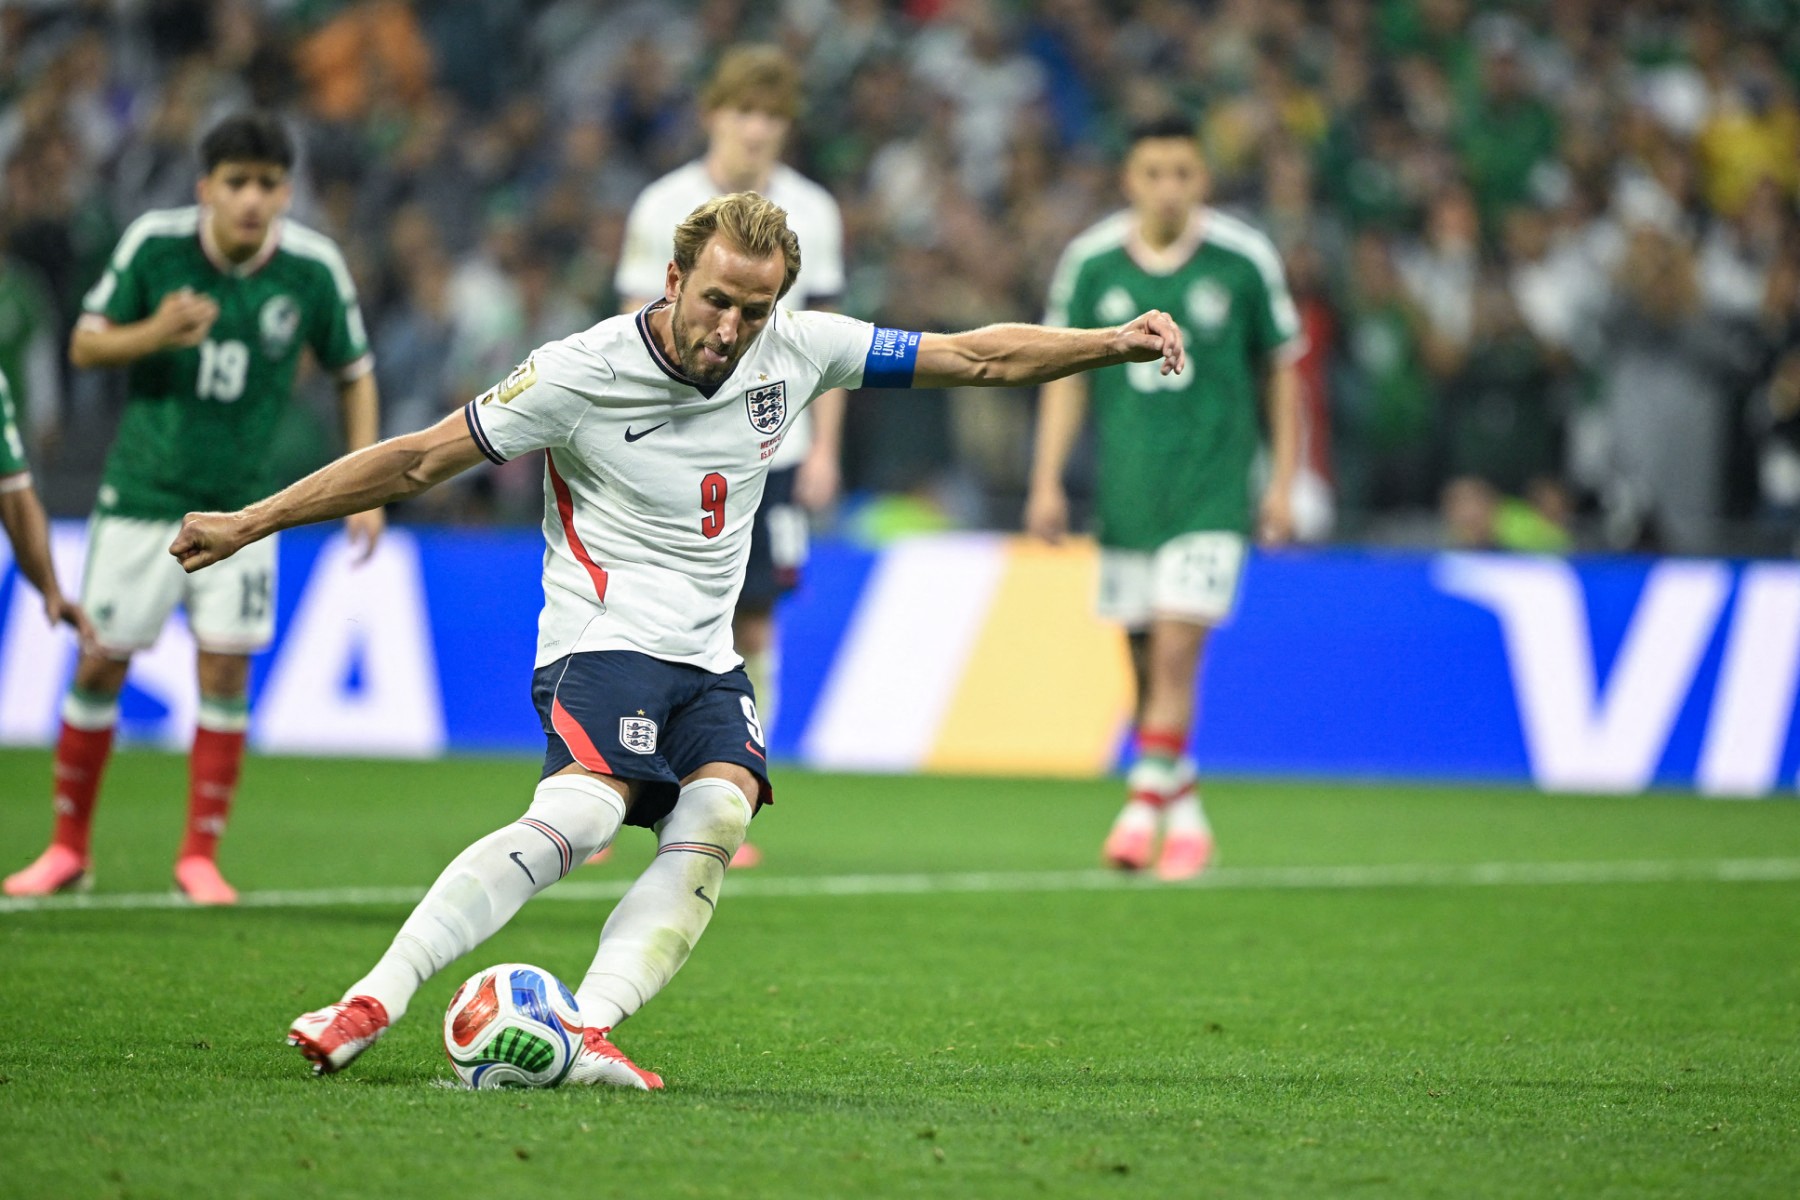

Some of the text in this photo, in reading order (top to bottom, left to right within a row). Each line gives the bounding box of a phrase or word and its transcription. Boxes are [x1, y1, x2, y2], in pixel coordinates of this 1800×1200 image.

[195, 338, 250, 403] 19
[760, 433, 782, 450] MEXICO
[700, 471, 728, 540] 9
[739, 695, 766, 748] 9
